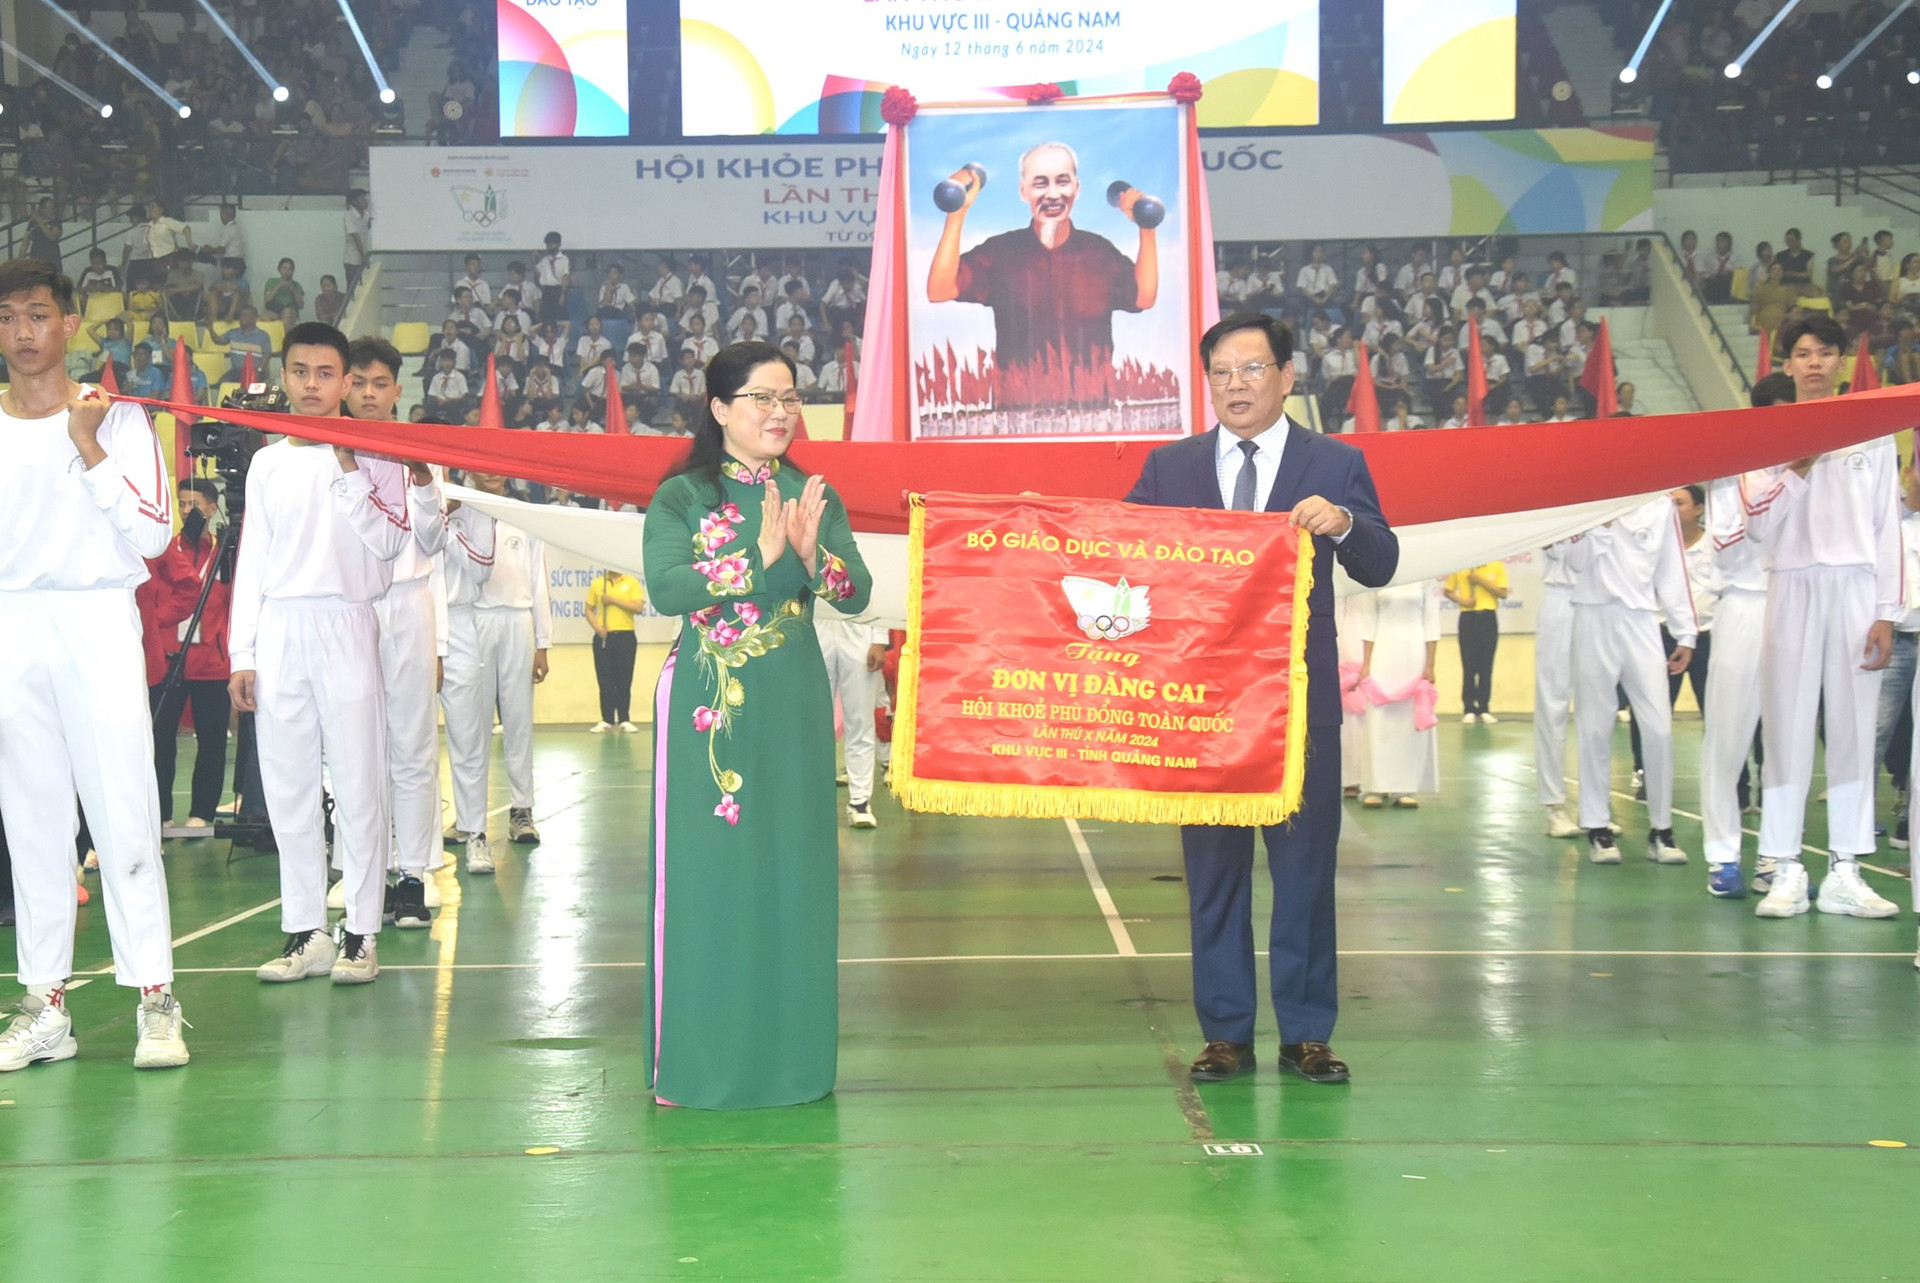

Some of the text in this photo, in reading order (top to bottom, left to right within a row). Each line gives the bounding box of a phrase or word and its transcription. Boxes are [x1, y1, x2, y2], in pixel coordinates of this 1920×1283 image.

[886, 15, 924, 31] KHU
[929, 13, 968, 34] VỰC
[974, 14, 989, 30] III
[1006, 8, 1073, 32] QUẢNG
[1078, 11, 1121, 28] NAM
[945, 42, 961, 56] 12
[968, 40, 1009, 58] tháng
[1016, 41, 1024, 54] 6
[1066, 39, 1104, 54] 2024
[636, 143, 1283, 184] HỘI KHỎE PH UỐC
[763, 183, 880, 204] LẦN TH
[763, 210, 828, 225] KHU
[967, 529, 1255, 568] BỘ GIÁO DỤC VÀ ĐÀO TẠO
[1065, 642, 1142, 667] Tặng
[992, 668, 1206, 703] ĐƠN VỊ ĐĂNG CAI
[961, 697, 1234, 733] HỘI KHOẺ PHÙ ĐỔNG TOÀN QUỐC
[1033, 724, 1159, 748] LẦN THỨ X NĂM 2024
[992, 743, 1021, 756] KHU
[1025, 746, 1053, 761] VỰC
[1056, 747, 1067, 759] III
[1078, 745, 1107, 761] TỈNH
[1111, 750, 1161, 767] QUẢNG
[1165, 755, 1197, 769] NAM
